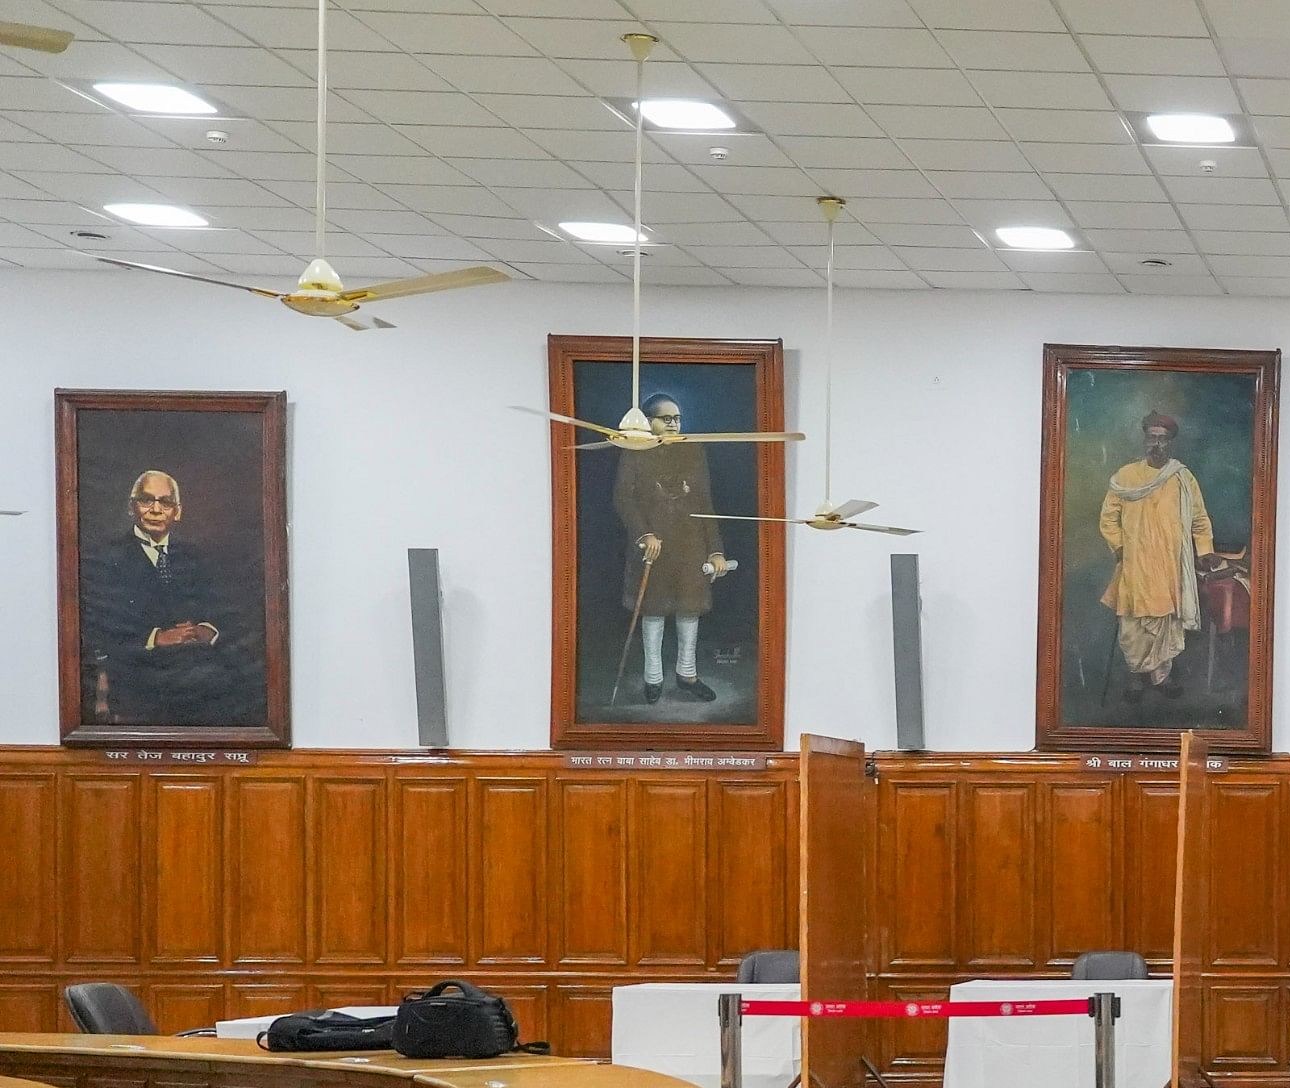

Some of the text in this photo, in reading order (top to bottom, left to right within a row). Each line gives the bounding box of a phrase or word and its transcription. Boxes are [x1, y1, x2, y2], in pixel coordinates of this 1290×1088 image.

[105, 751, 129, 760] सर
[137, 750, 163, 760] तेज
[170, 751, 217, 763] बहादुर
[596, 756, 613, 766] रत्न
[1085, 756, 1180, 768] श्री बाल गंगाधर
